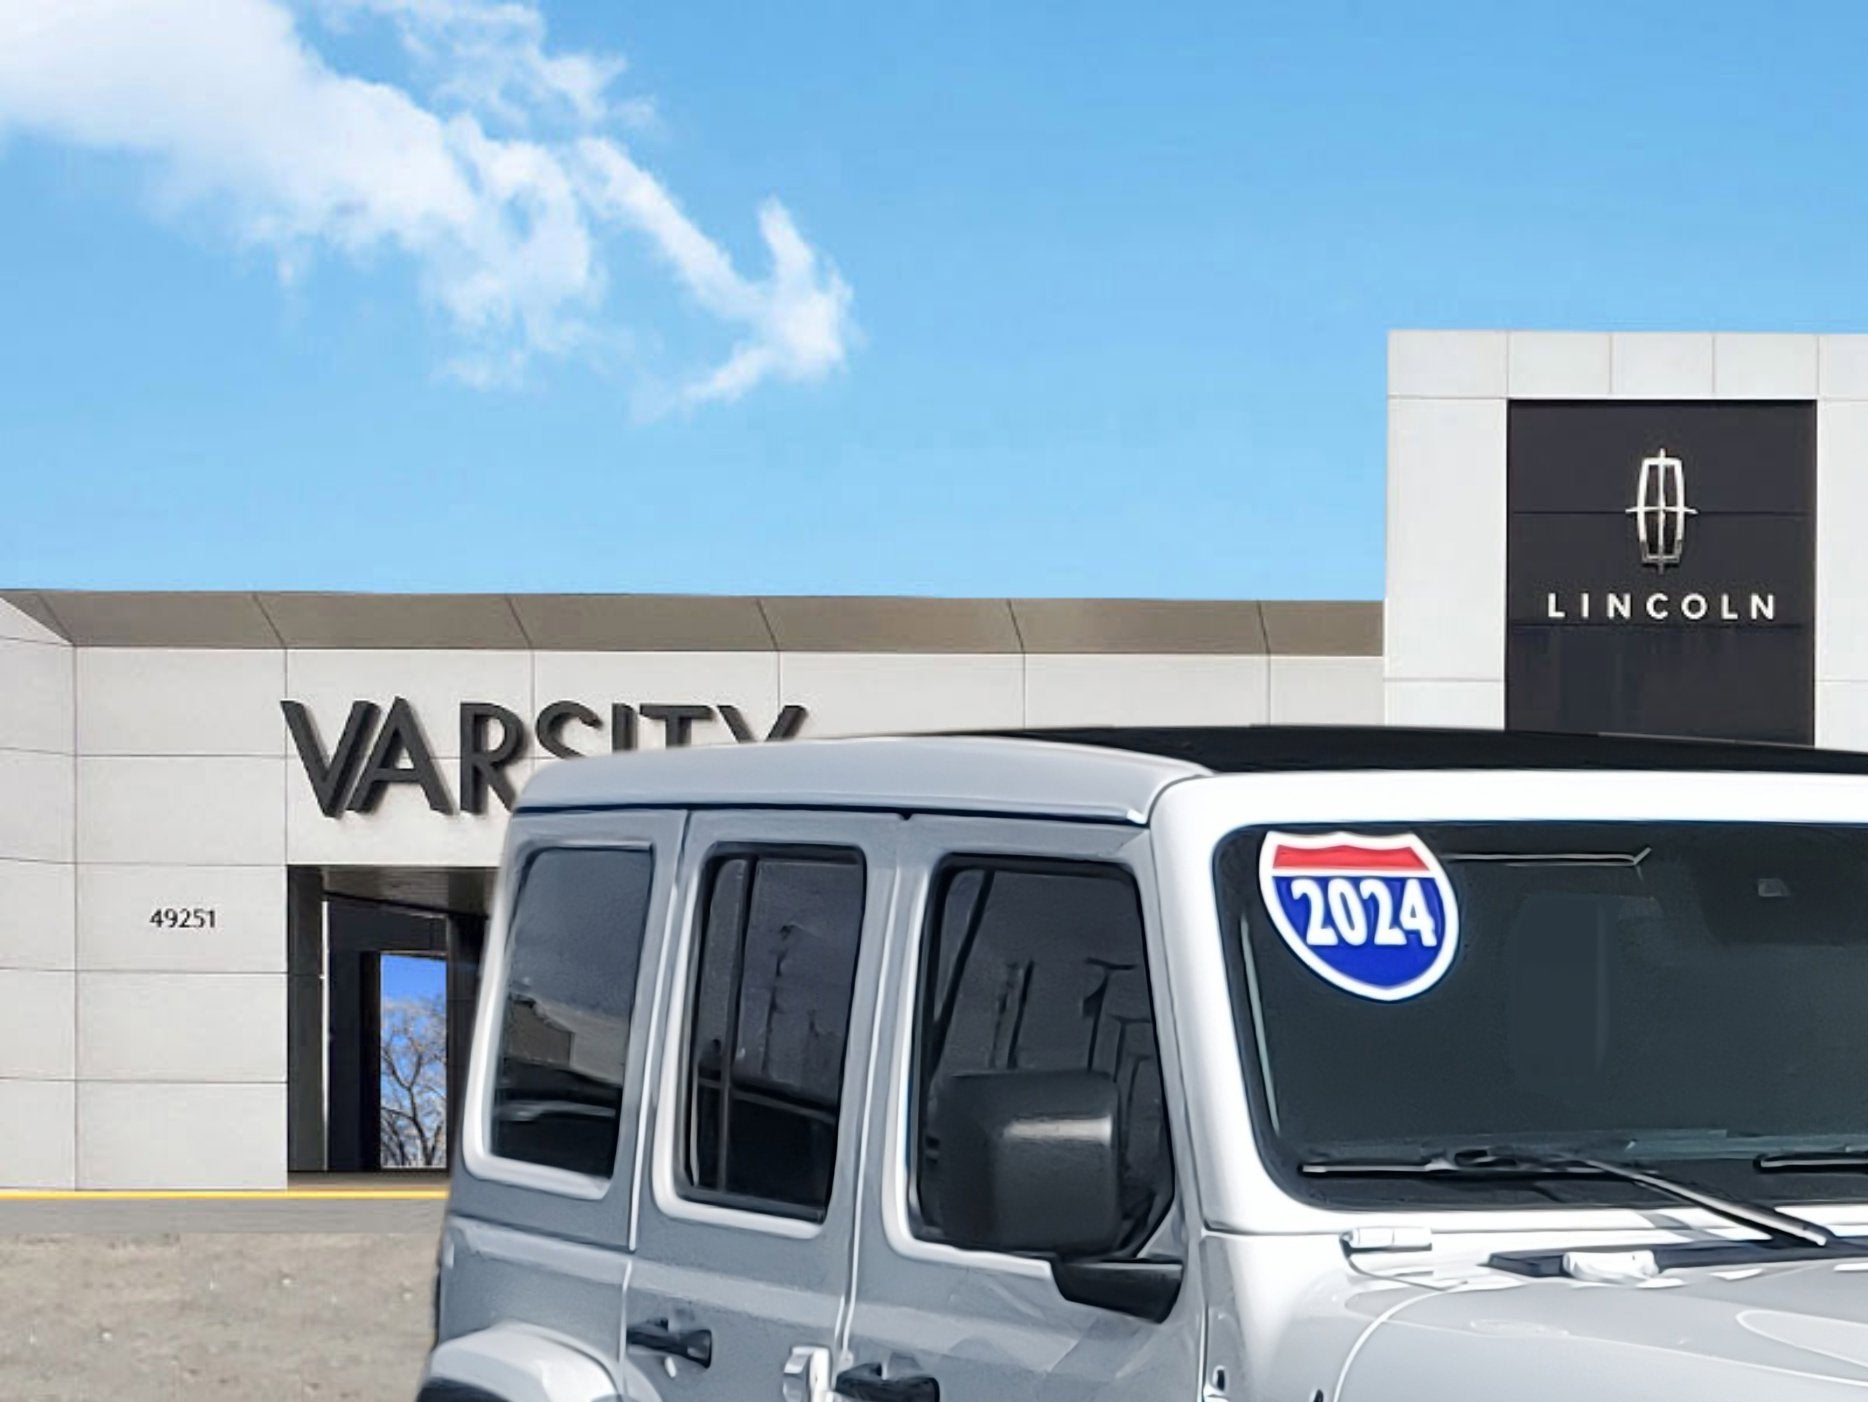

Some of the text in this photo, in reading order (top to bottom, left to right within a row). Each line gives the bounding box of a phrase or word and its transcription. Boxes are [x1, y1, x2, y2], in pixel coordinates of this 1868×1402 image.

[1547, 592, 1775, 621] LINCOLN
[149, 907, 216, 929] 49251
[1290, 878, 1438, 948] 2024
